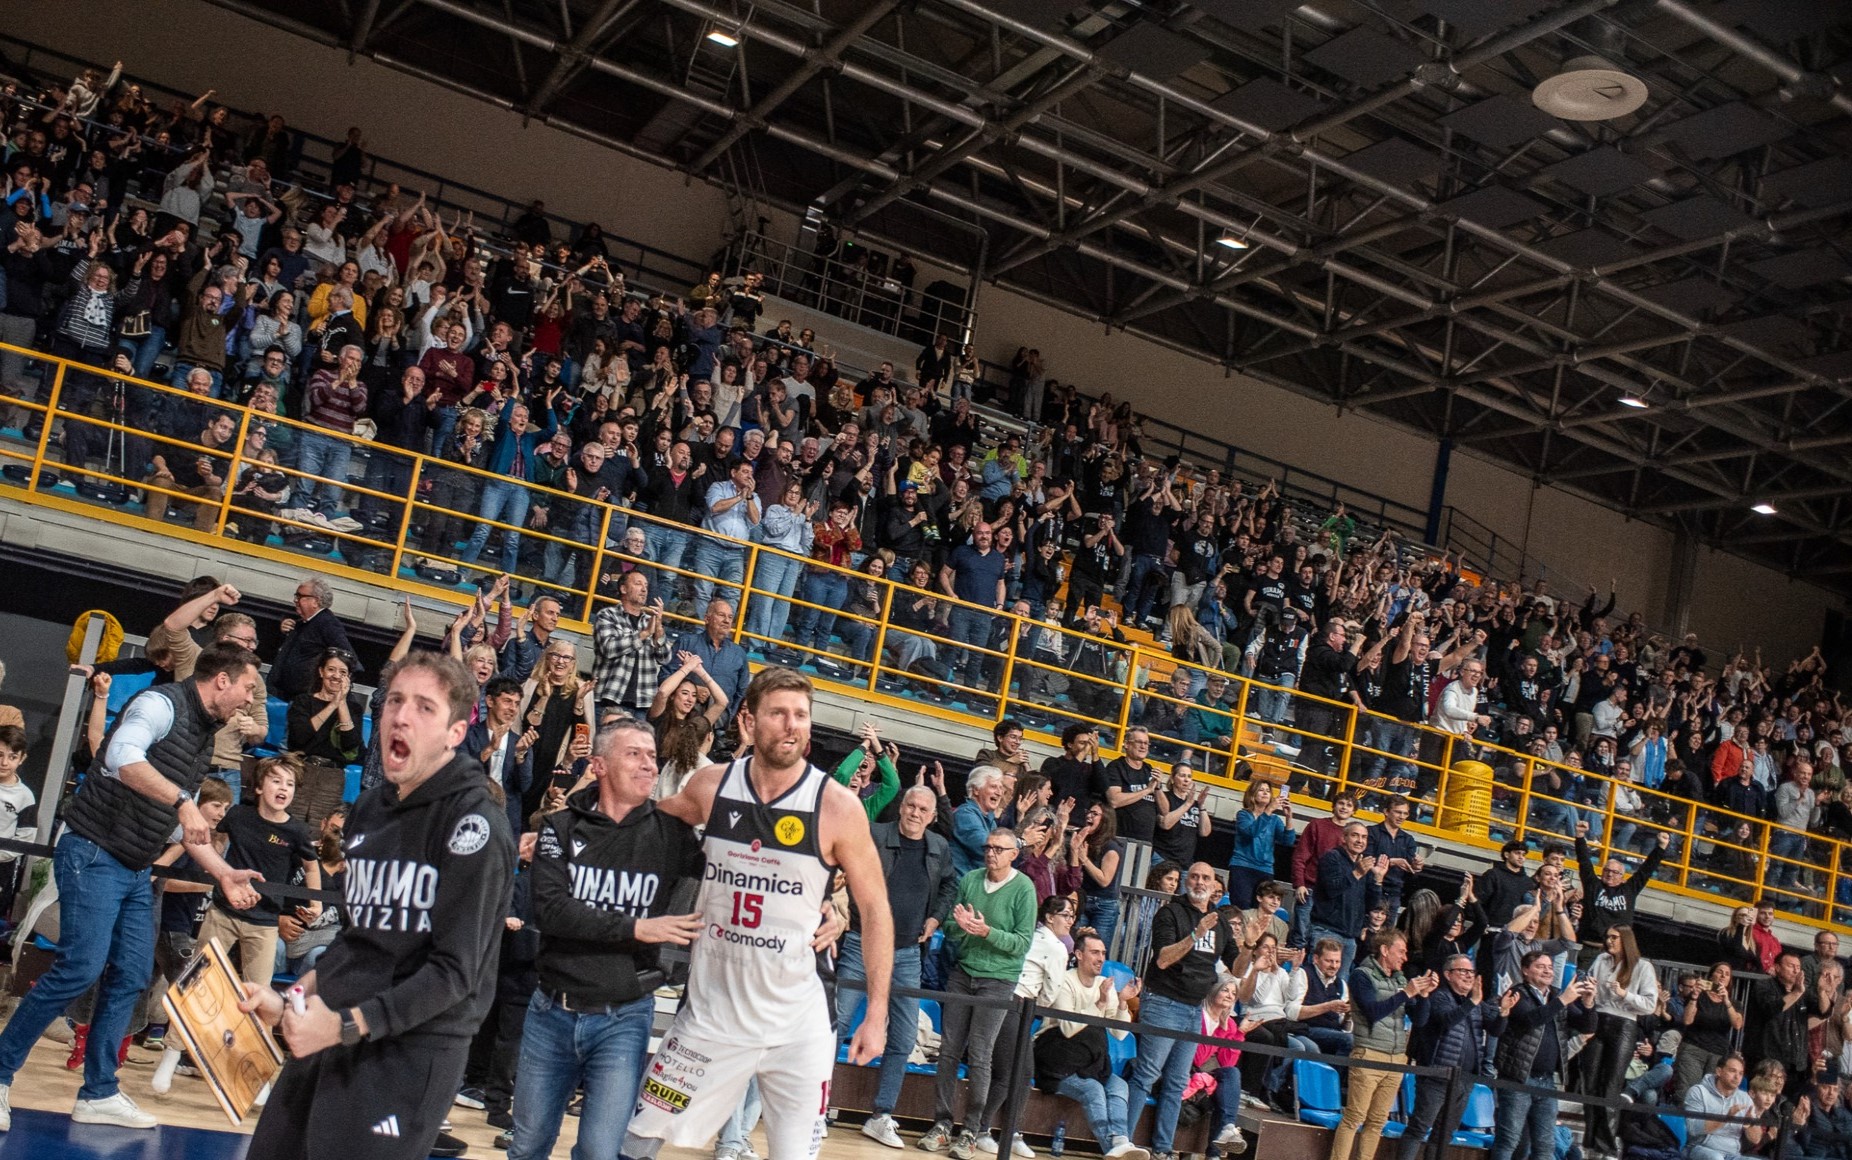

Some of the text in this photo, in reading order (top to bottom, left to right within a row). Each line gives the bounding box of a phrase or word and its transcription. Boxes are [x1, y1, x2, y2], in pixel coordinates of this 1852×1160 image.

[705, 862, 803, 896] Dinamica
[346, 905, 433, 933] RIZIA
[730, 891, 764, 929] 15
[724, 930, 786, 953] comody
[819, 1080, 832, 1115] 1
